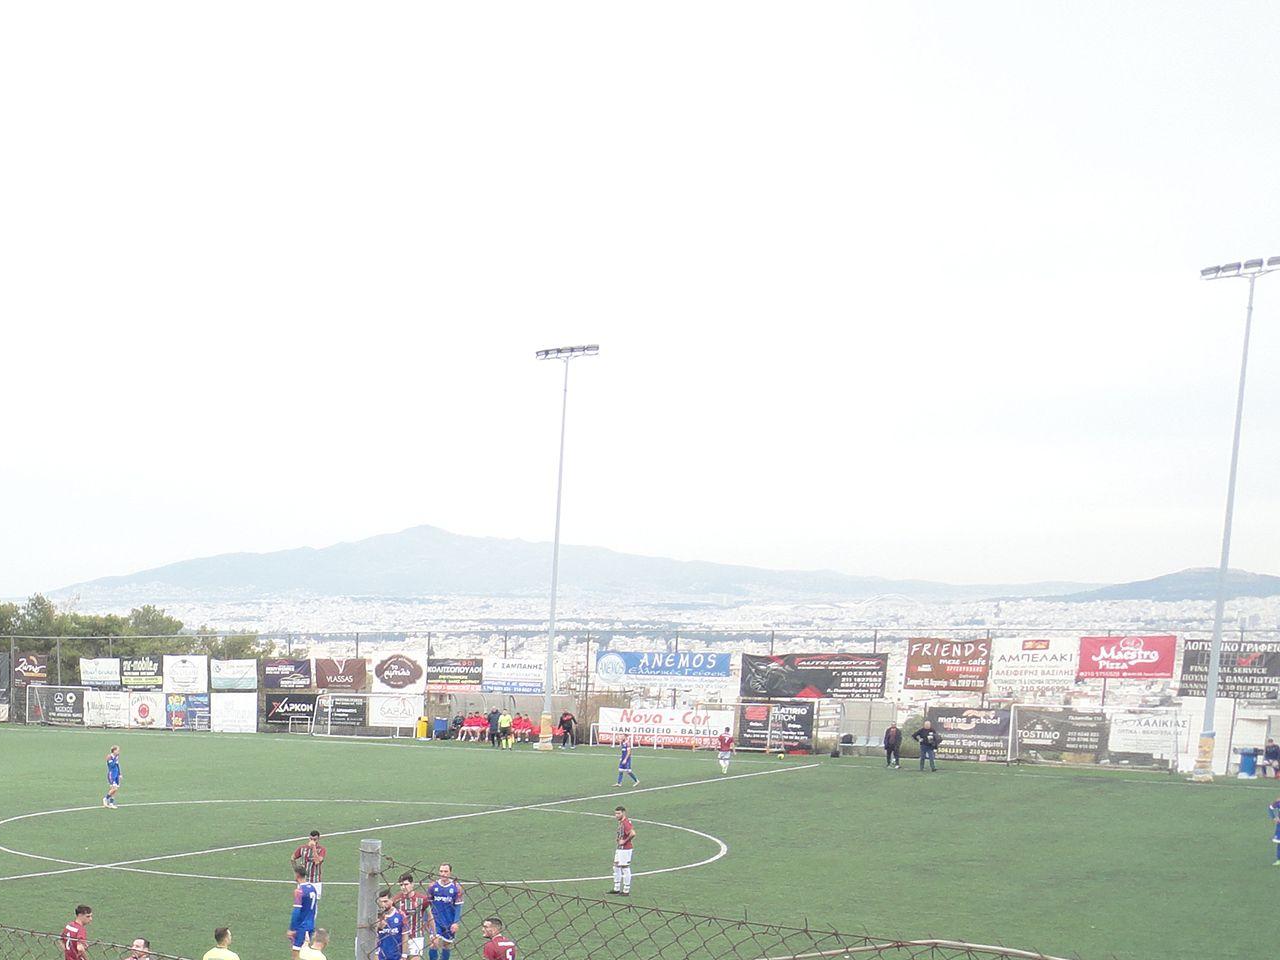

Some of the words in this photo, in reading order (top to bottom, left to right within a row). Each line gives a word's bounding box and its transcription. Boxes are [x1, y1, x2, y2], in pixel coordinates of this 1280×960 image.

[910, 643, 988, 657] FRIENDS
[638, 653, 717, 669] ANEMOS
[998, 653, 1073, 663] ΑΜΠΕΛΑΚΙ
[1190, 665, 1232, 674] FINAIAL
[326, 675, 354, 684] VLASSAS
[620, 709, 663, 724] Nova
[682, 711, 712, 725] Car
[1017, 729, 1060, 740] TOSTIMO
